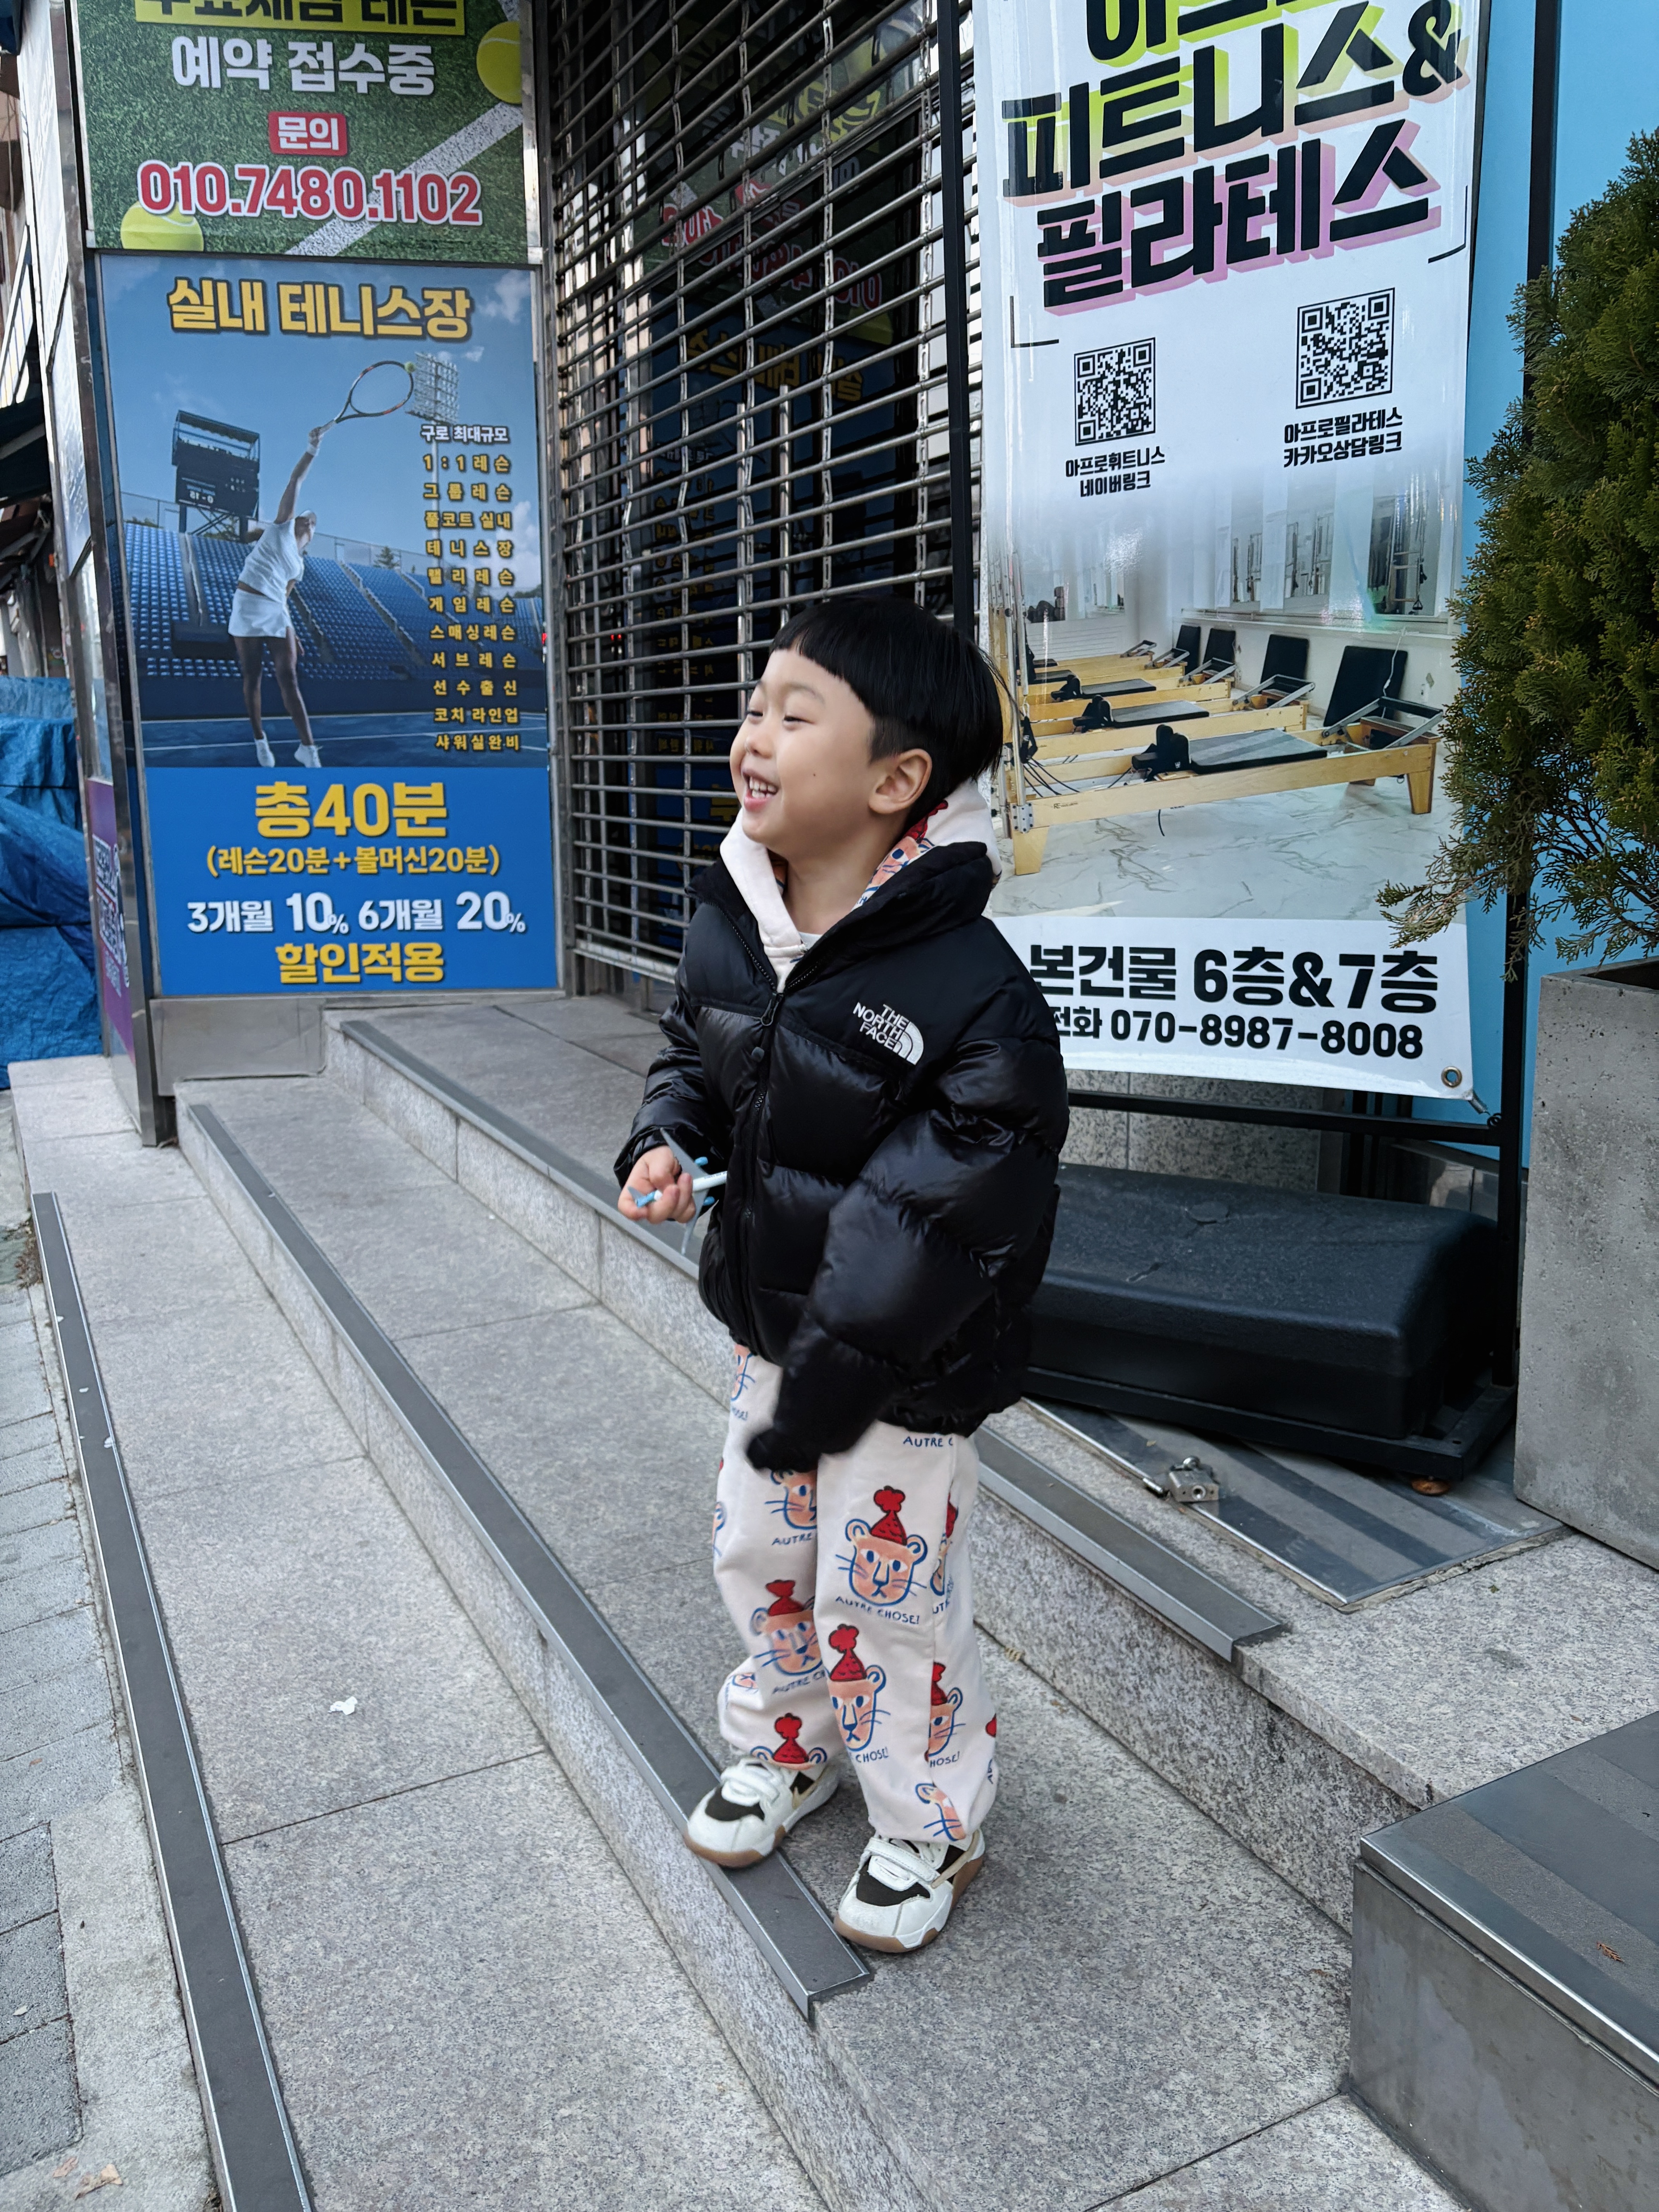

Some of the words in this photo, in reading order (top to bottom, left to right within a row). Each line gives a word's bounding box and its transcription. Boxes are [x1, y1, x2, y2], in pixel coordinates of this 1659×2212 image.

[172, 36, 272, 90] 예약
[288, 41, 435, 96] 접수중
[277, 116, 339, 151] 문의
[138, 160, 482, 225] 010.7480.1102
[1037, 118, 1429, 308] 필라테스
[168, 278, 267, 332] 실내
[278, 282, 474, 341] 테니스장
[421, 426, 450, 441] 구로
[453, 426, 508, 443] 최대규모
[1284, 407, 1403, 443] 아프로필라테스
[1065, 446, 1166, 477] 아프로휘트니스
[1283, 431, 1402, 468] 카카오상담링크
[1080, 470, 1151, 498] 네이버링크
[434, 708, 465, 723] 코치
[472, 708, 519, 723] 라인업
[255, 781, 448, 837] 총40분
[187, 900, 273, 933] 3개월
[286, 891, 349, 934] 10%
[358, 899, 443, 931] 6개월
[455, 891, 526, 932] 20%
[275, 942, 445, 984] 할인적용
[1030, 945, 1177, 1000] 본건물
[1194, 946, 1438, 1014] 6층&7층
[853, 1001, 903, 1040] NORTH
[881, 1004, 910, 1030] THE
[1111, 1009, 1423, 1060] 070-8987-8008
[859, 1021, 898, 1050] FACE
[903, 1436, 943, 1447] AUTRE
[771, 1532, 812, 1546] AUTRE
[835, 1596, 872, 1614] AUTRE
[877, 1608, 920, 1625] CHOSE!
[855, 1746, 889, 1763] CHOSE!
